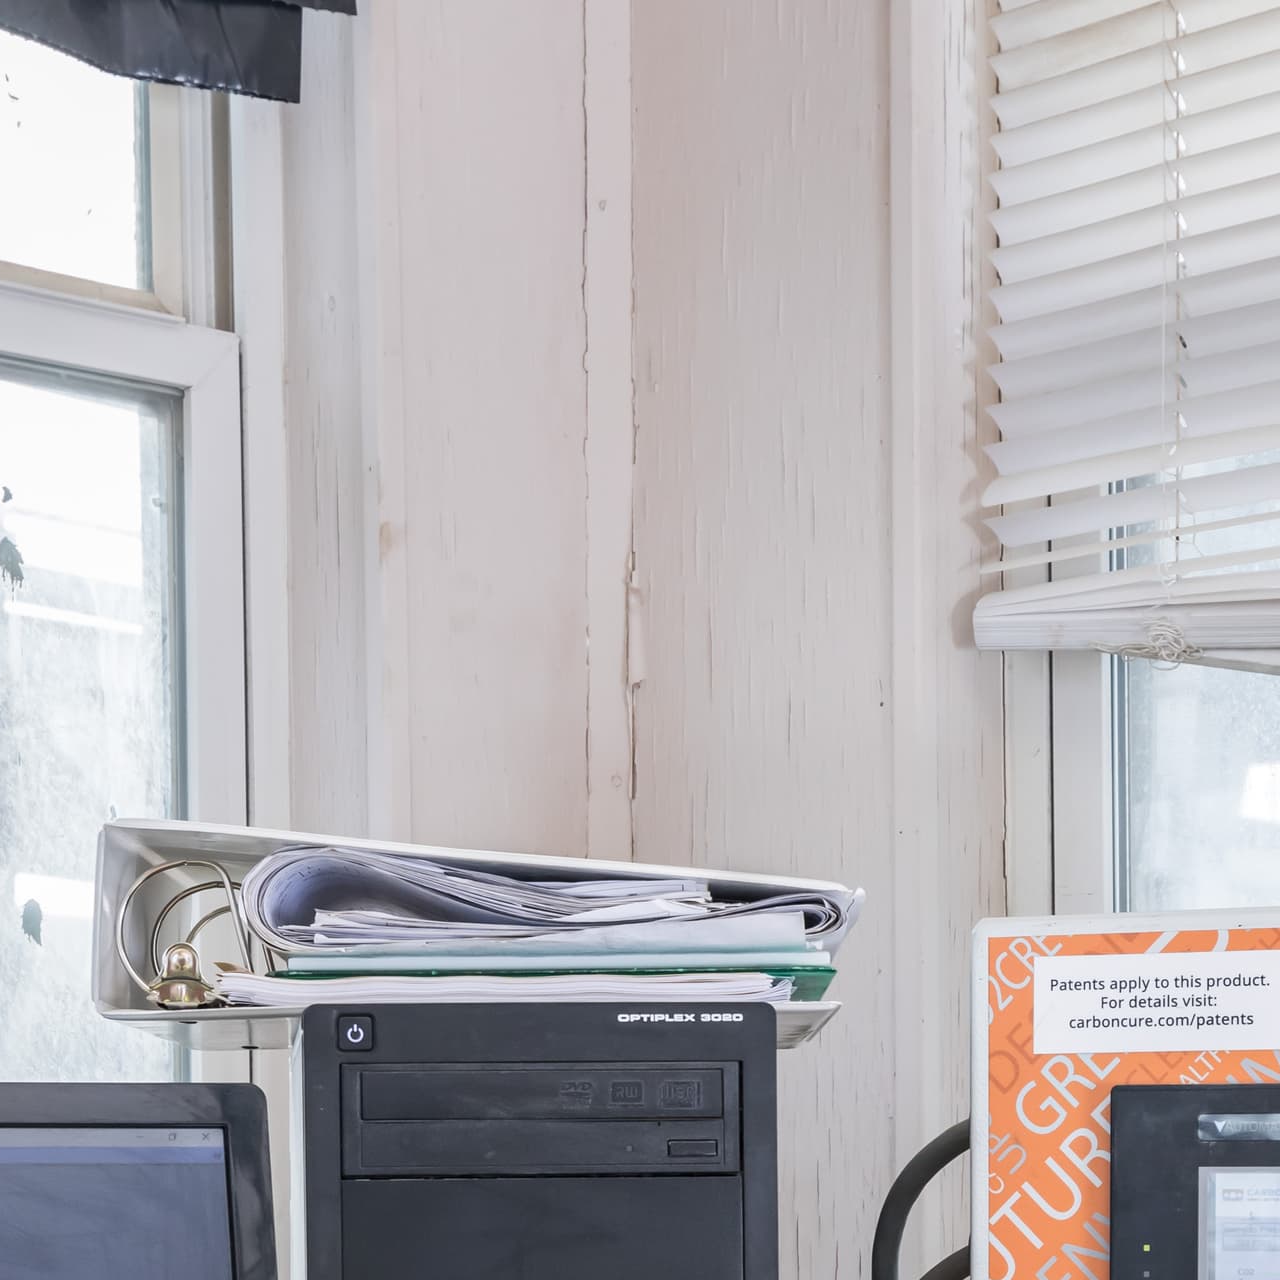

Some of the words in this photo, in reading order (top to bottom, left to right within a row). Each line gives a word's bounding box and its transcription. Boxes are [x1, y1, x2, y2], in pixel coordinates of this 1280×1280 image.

[1050, 978, 1105, 992] Patents
[1111, 976, 1150, 993] apply
[1154, 977, 1170, 990] to
[1174, 974, 1202, 988] this
[1206, 973, 1270, 991] product.
[1101, 996, 1124, 1009] For
[1128, 995, 1178, 1009] details
[1182, 994, 1218, 1008] visit:
[617, 1013, 696, 1023] OPTIPLEX
[700, 1013, 744, 1022] 3020
[1069, 1013, 1254, 1029] carboncure.com/patents
